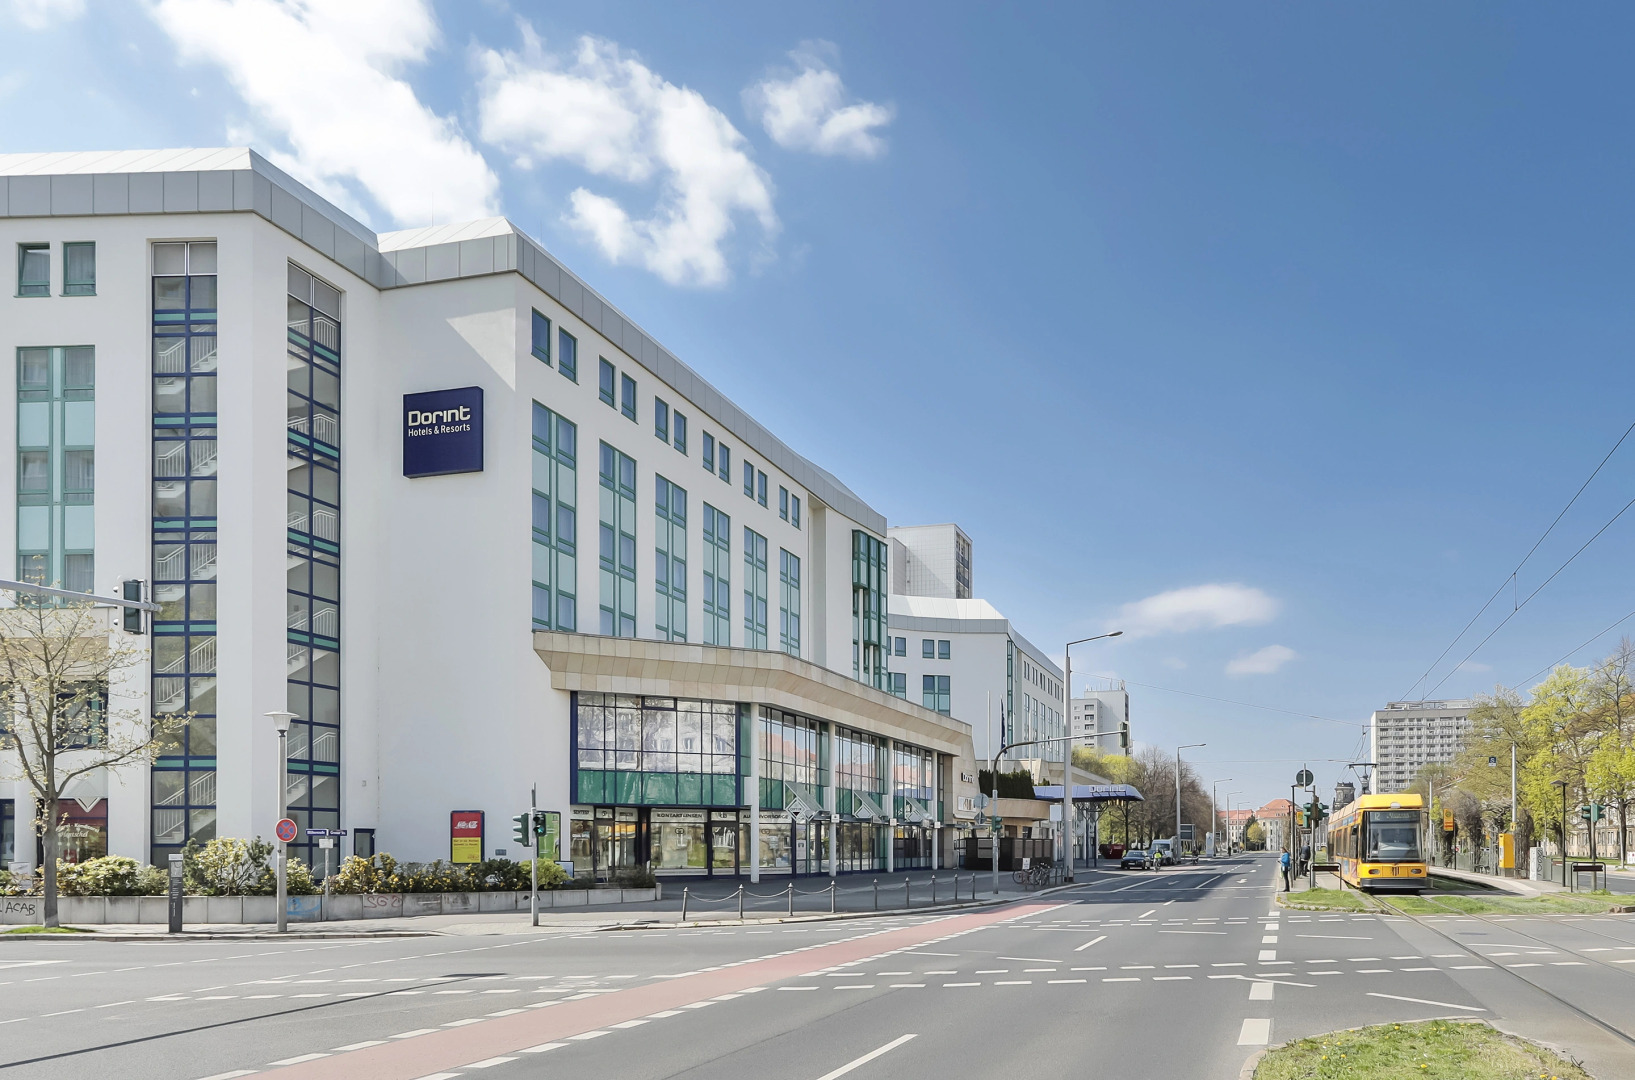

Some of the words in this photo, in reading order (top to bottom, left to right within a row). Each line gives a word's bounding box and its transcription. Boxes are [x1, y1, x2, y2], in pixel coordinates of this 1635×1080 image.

[408, 406, 471, 427] Dorint
[408, 427, 433, 437] Hotels
[433, 425, 440, 435] &
[440, 423, 471, 434] Resorts
[5, 901, 36, 916] ACAB
